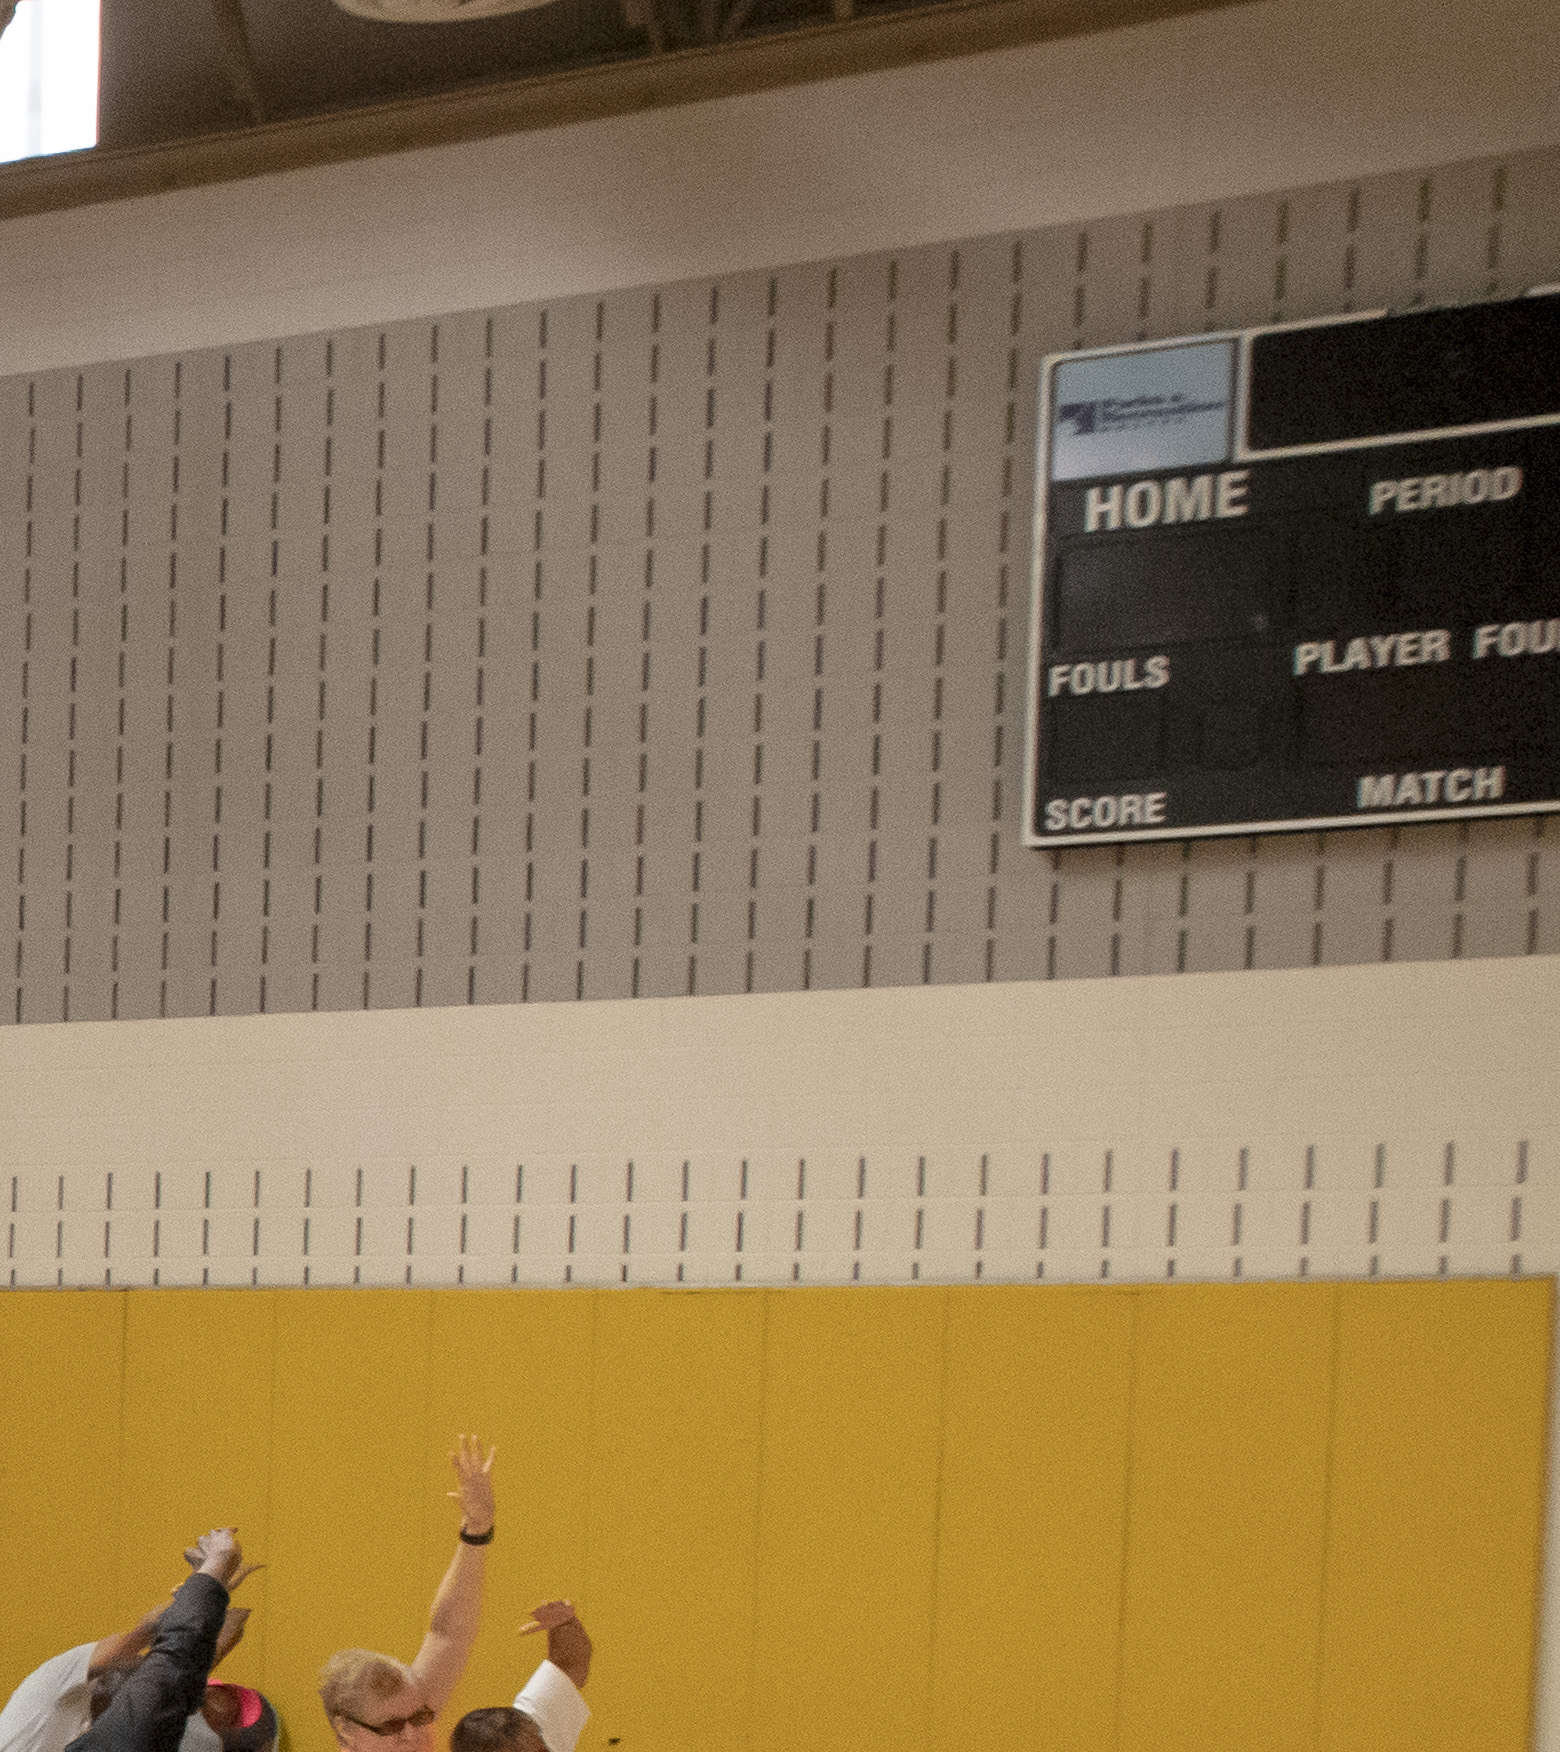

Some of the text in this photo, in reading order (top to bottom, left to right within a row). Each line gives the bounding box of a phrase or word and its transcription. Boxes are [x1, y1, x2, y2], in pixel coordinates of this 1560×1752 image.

[1084, 470, 1251, 533] HOME
[1368, 466, 1521, 516] PERIOD
[1293, 629, 1451, 675] PLAYER
[1048, 655, 1170, 697] FOULS
[1356, 765, 1507, 808] MATCH
[1044, 791, 1168, 831] SCORE
